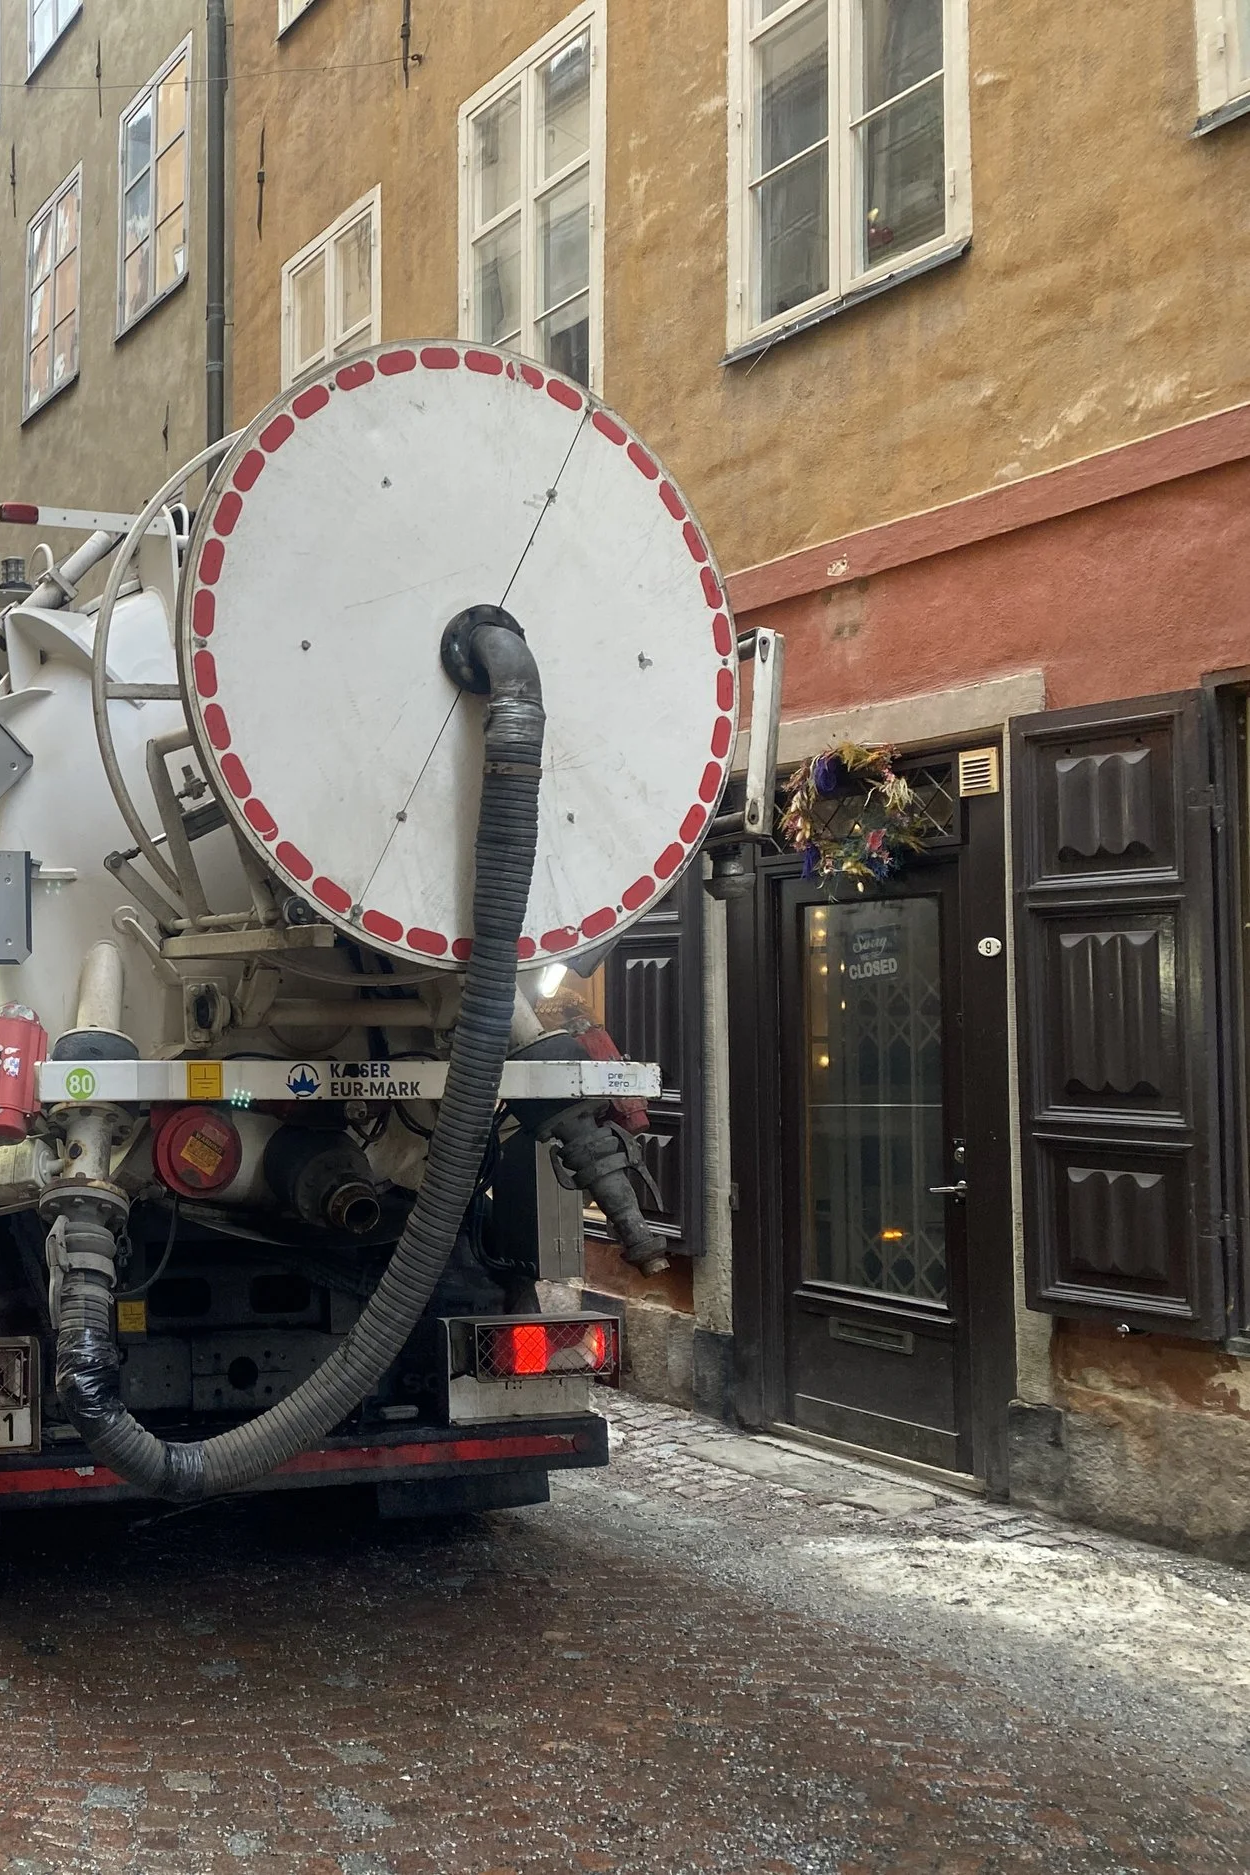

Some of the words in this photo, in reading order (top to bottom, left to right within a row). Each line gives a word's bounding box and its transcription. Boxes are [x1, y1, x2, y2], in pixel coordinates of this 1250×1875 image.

[985, 941, 992, 954] 9
[848, 957, 898, 980] CLOSED
[329, 1063, 391, 1078] KASER
[607, 1072, 624, 1080] pre
[69, 1074, 93, 1094] 80
[330, 1081, 421, 1097] EUR-MARK
